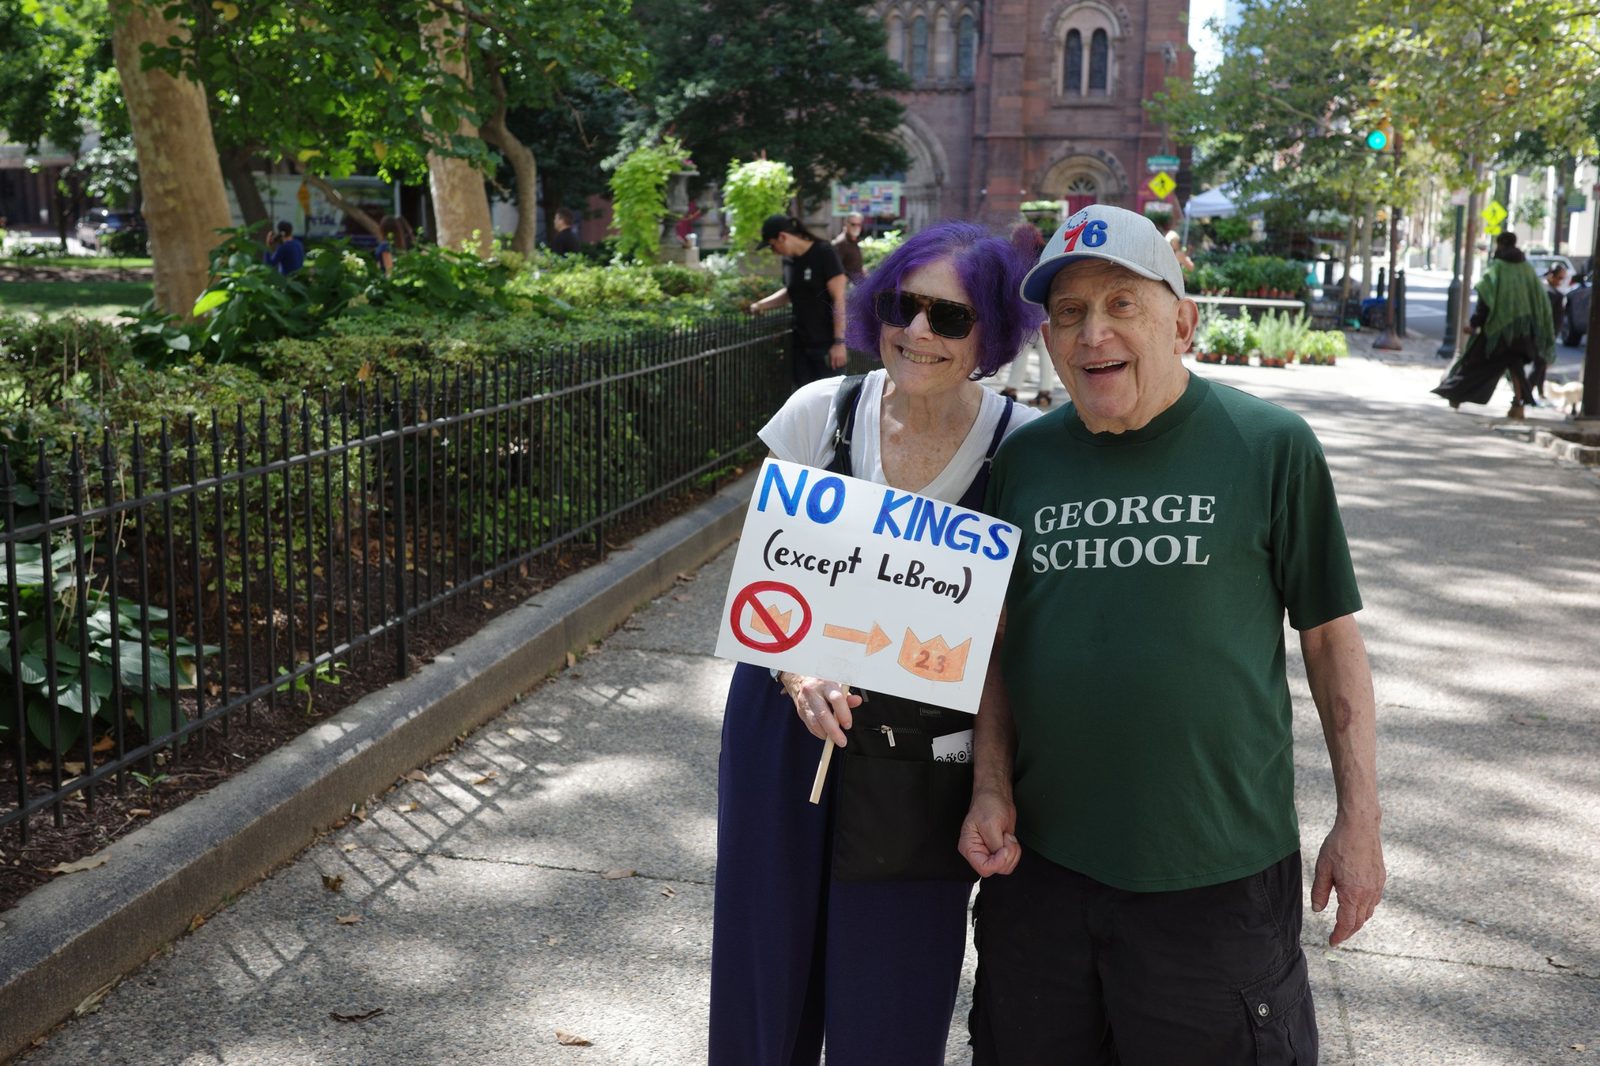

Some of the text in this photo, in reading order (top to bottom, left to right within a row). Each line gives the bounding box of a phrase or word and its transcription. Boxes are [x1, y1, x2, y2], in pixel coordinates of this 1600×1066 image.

[1064, 220, 1108, 253] 76
[757, 463, 1013, 561] NO KINGS
[1034, 494, 1216, 534] GEORGE
[763, 529, 972, 604] (except LeBron)
[1032, 534, 1210, 573] SCHOOL
[915, 650, 946, 674] 23
